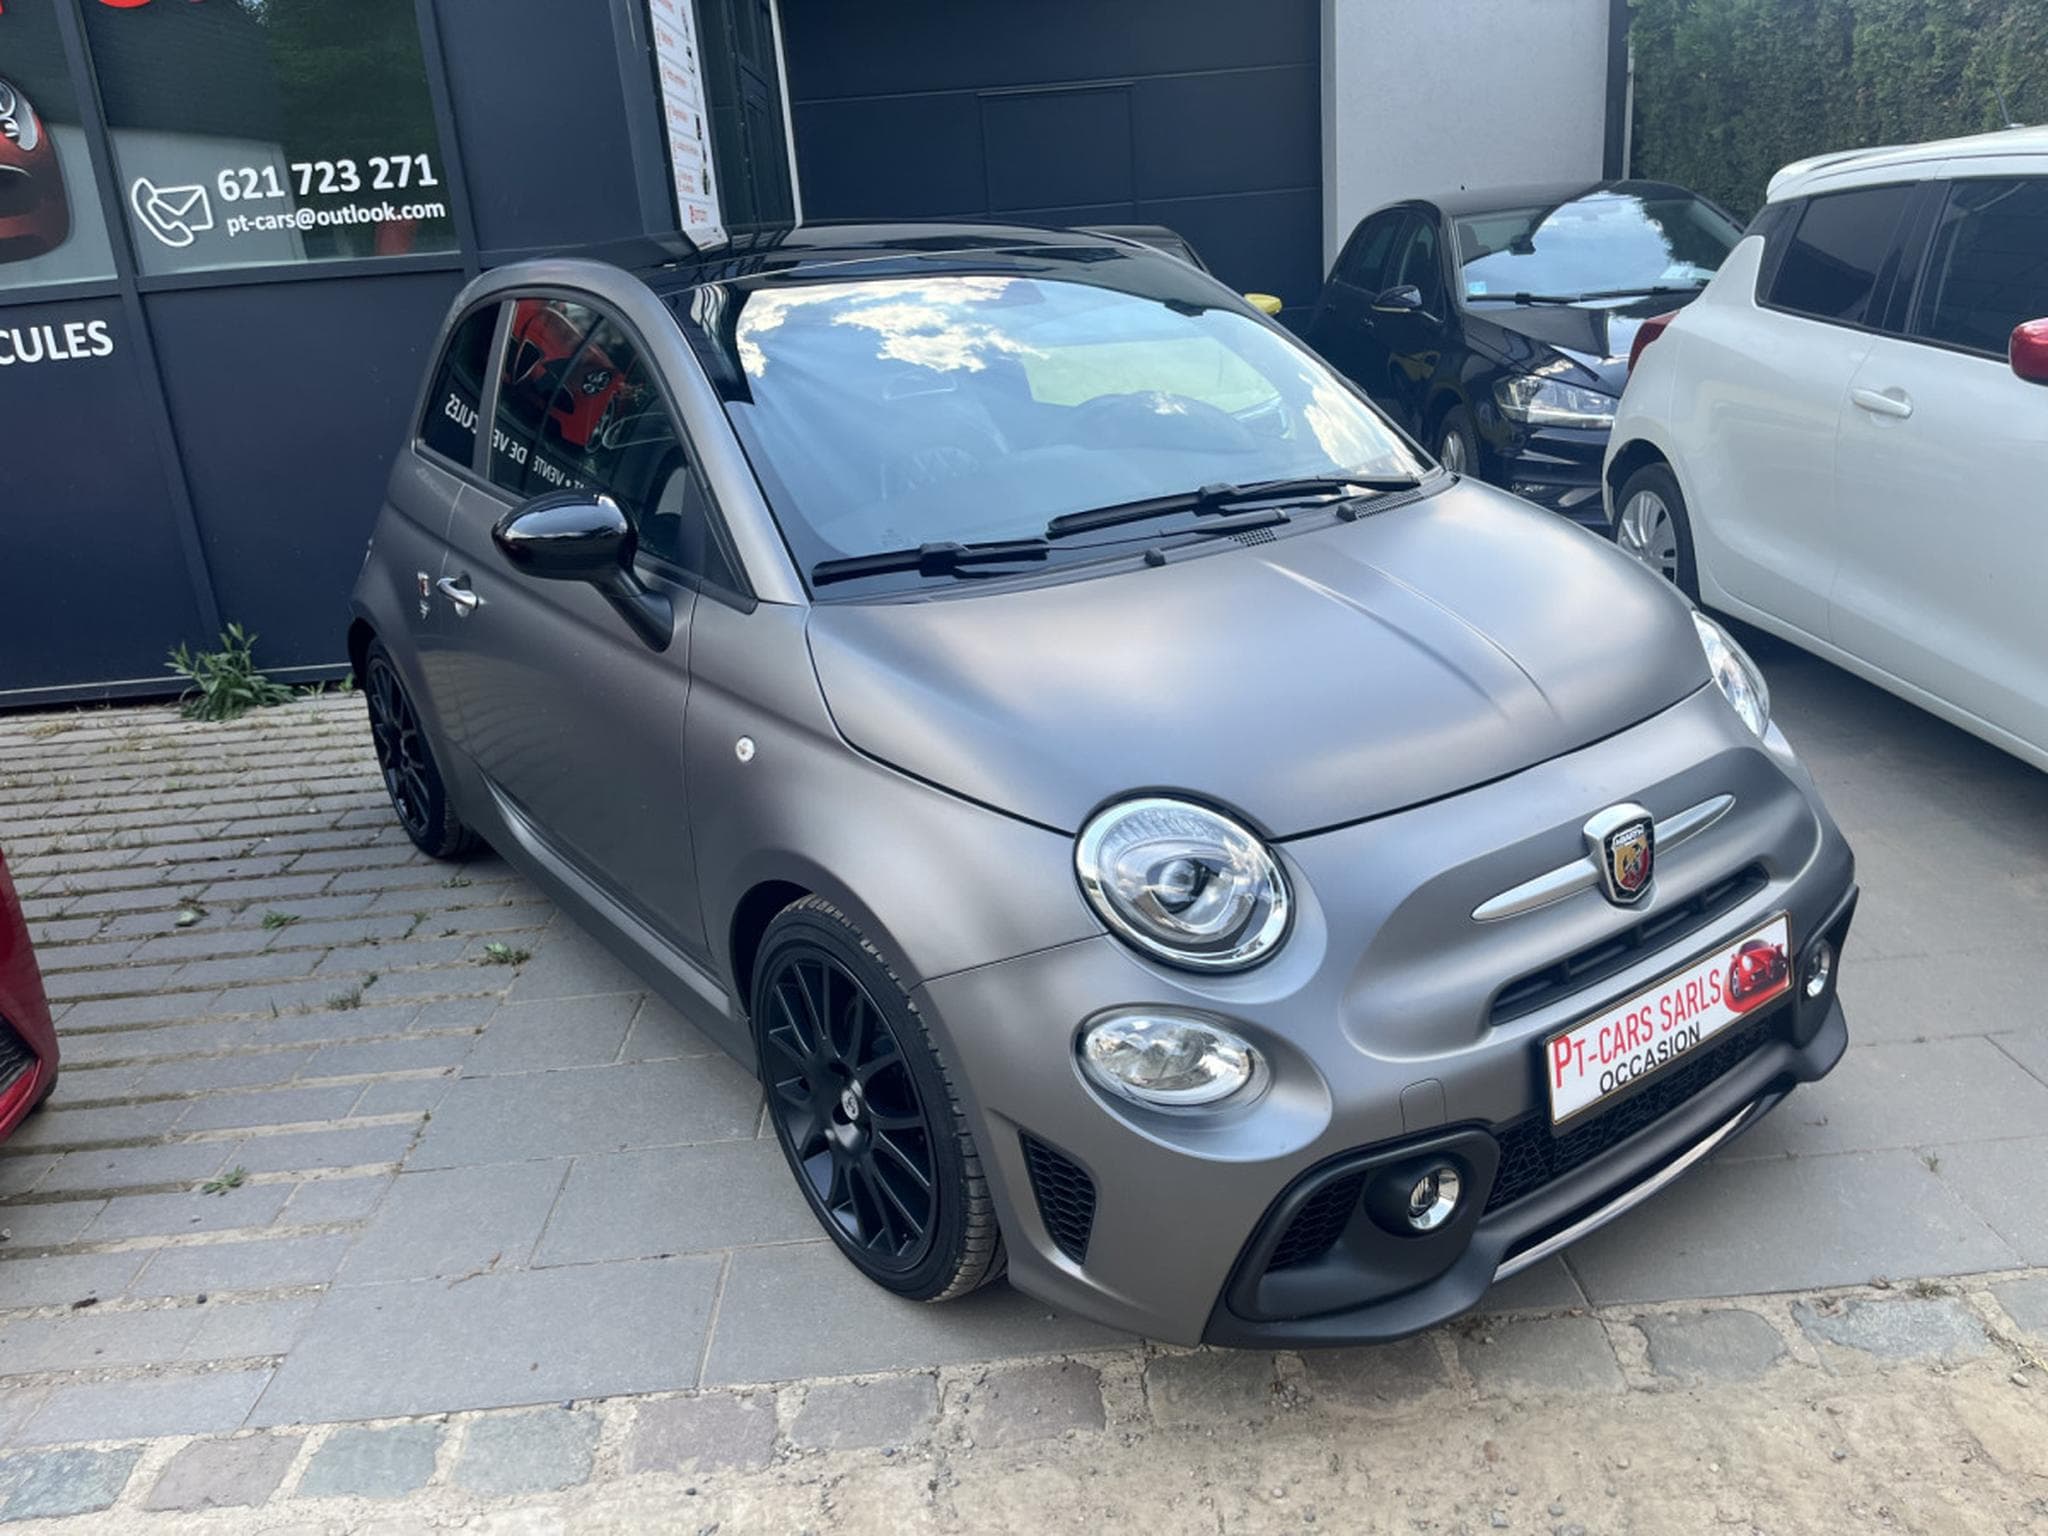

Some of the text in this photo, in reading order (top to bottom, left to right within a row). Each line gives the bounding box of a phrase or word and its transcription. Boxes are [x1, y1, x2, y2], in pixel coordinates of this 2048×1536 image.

[217, 154, 438, 201] 621 723 271
[226, 202, 446, 237] pt-cars@outlook.com
[1660, 969, 1721, 1031] SARLS
[1600, 1022, 1700, 1095] OCCASION
